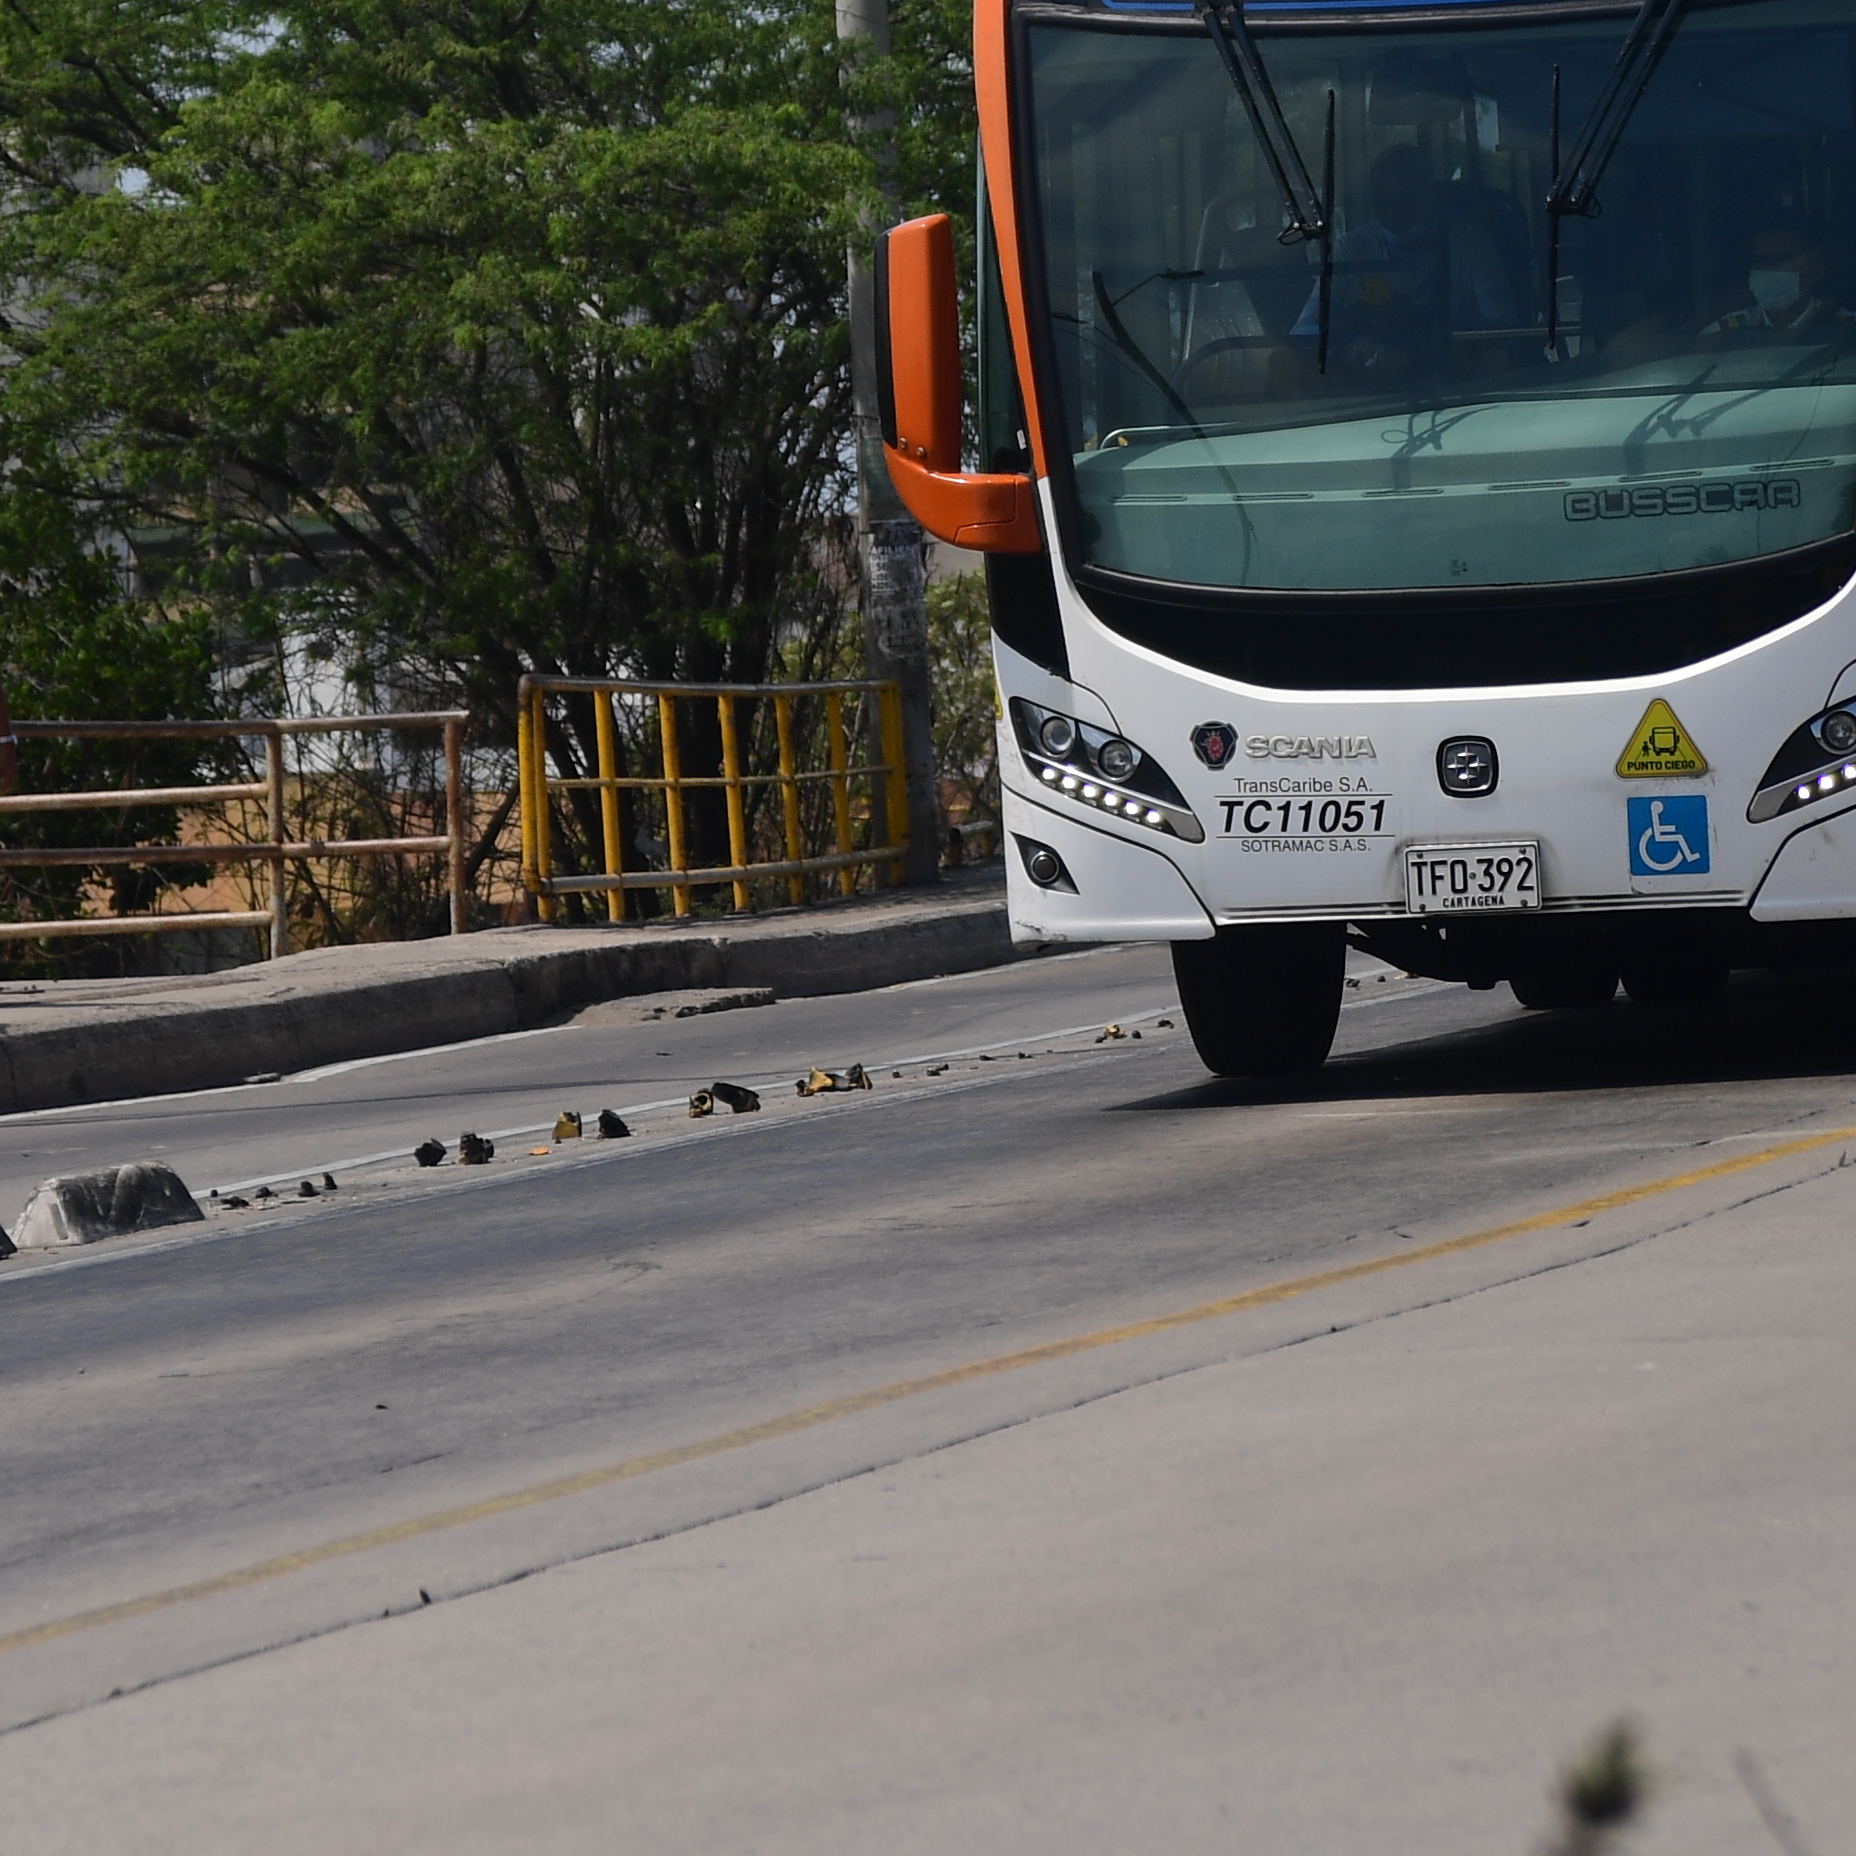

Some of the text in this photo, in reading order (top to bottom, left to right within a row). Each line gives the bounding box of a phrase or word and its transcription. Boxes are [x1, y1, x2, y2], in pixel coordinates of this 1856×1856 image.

[1563, 479, 1802, 522] BUSSCAR
[1245, 734, 1378, 760] SCANIA
[1627, 759, 1696, 772] PUNTO CIEGO
[1234, 776, 1373, 794] TransCaribe S.A.
[1218, 799, 1386, 834] TC11051
[1241, 838, 1371, 853] SOTRAMAC S.A.S.
[1442, 894, 1506, 909] CARTAGENA
